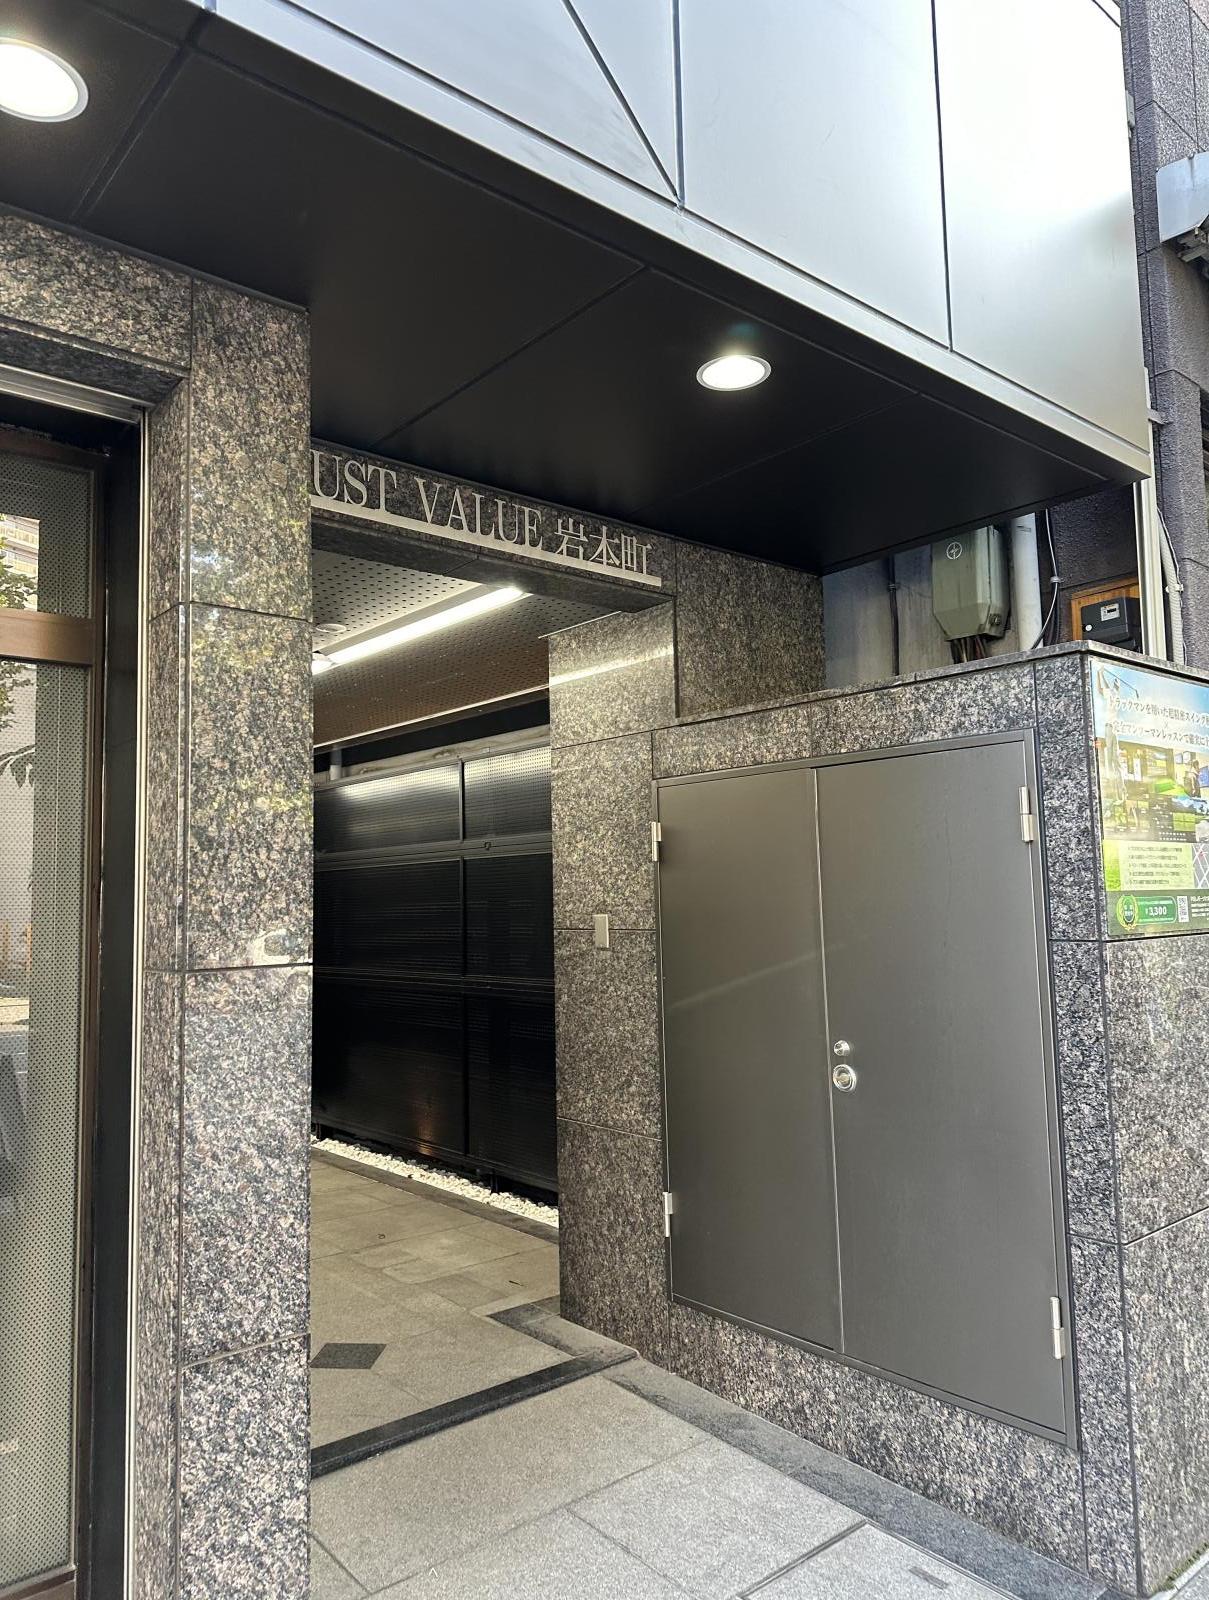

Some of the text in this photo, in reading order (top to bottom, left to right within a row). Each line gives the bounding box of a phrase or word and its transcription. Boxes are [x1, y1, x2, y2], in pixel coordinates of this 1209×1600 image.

[310, 449, 653, 575] UST VALUE 岩本町
